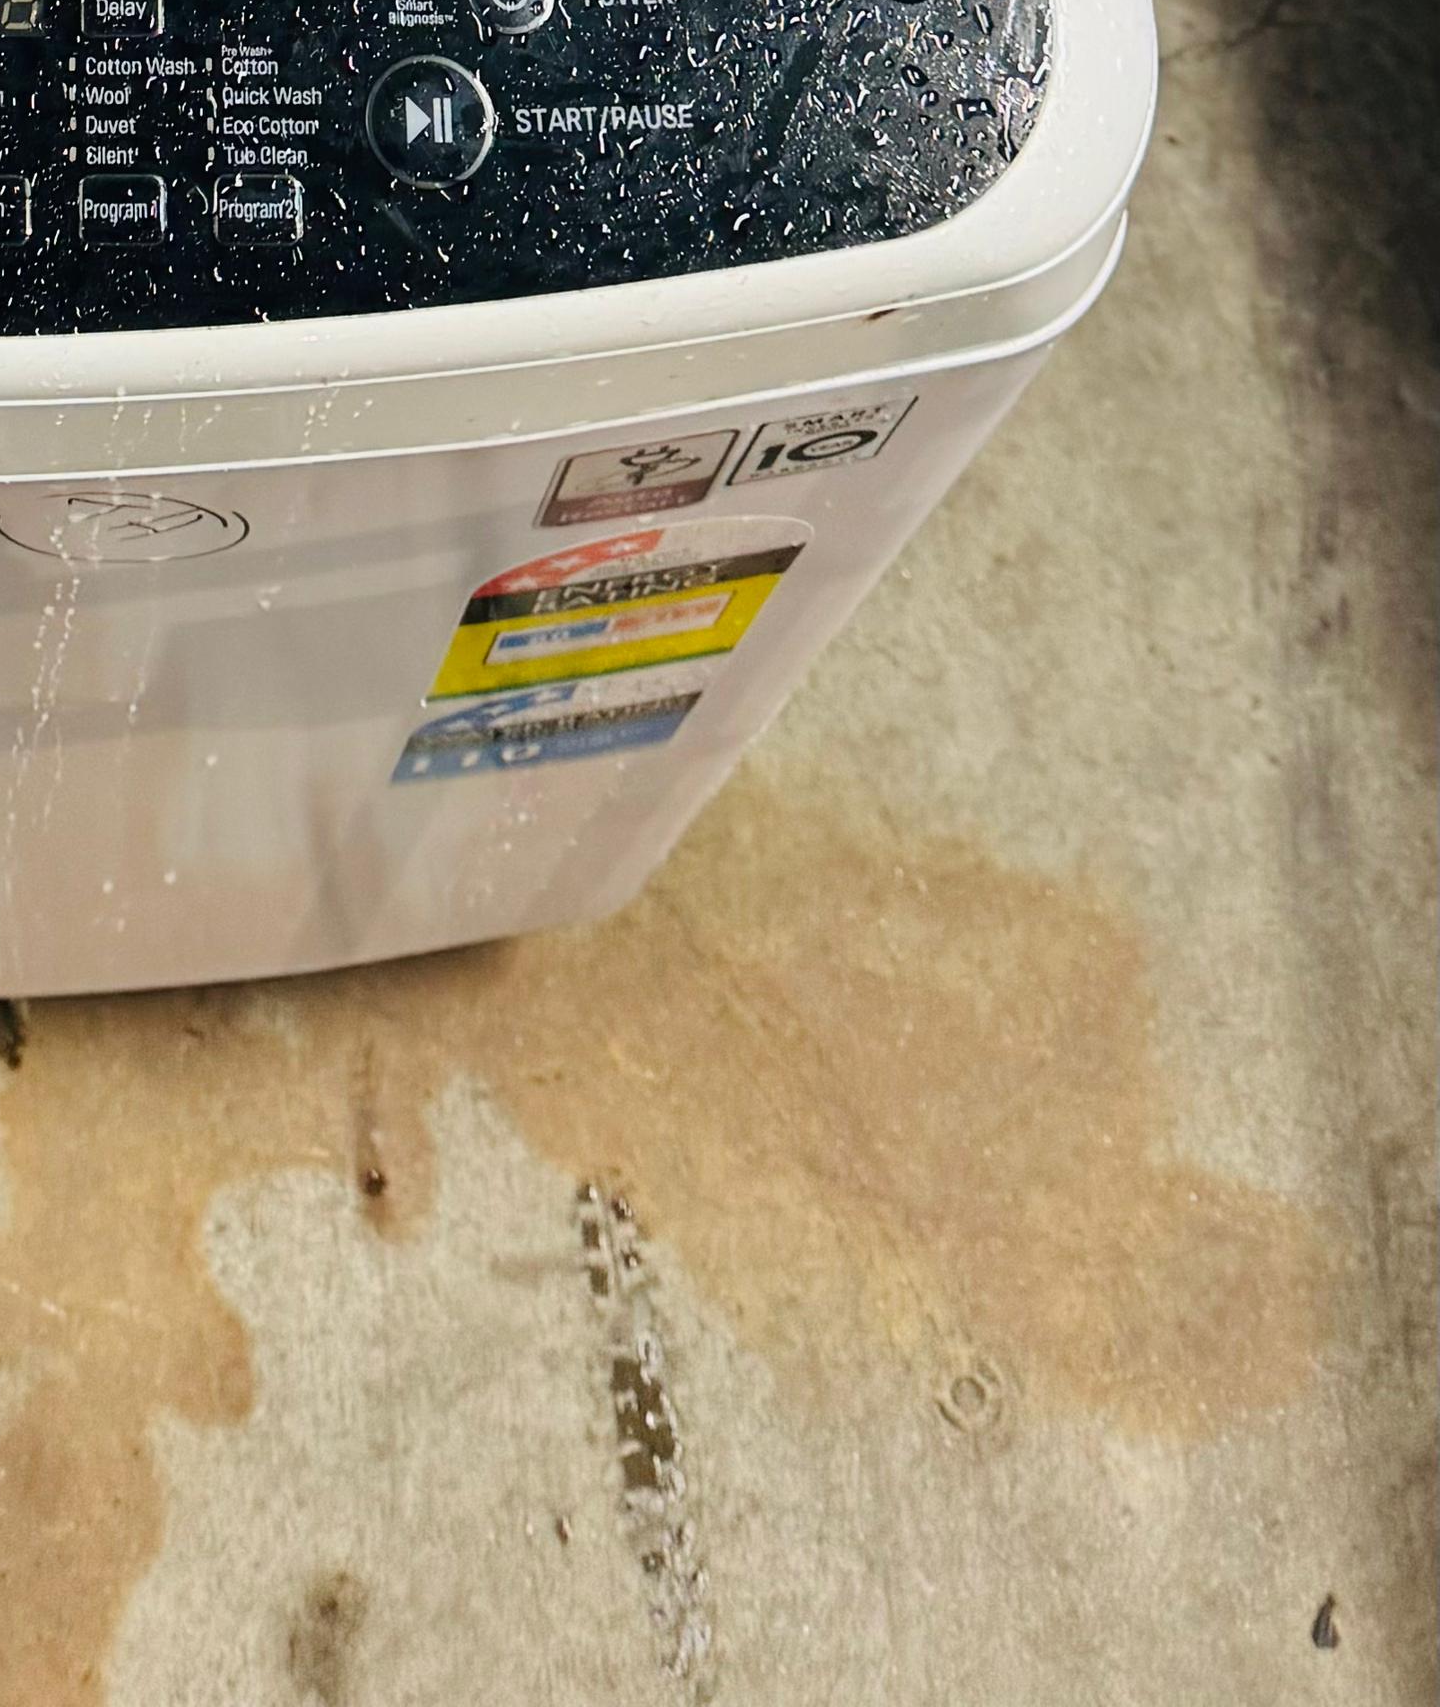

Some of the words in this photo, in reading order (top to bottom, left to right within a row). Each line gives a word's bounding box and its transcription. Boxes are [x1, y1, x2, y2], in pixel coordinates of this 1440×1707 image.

[86, 57, 142, 75] Cotton
[146, 57, 195, 75] Wash
[222, 57, 278, 75] Cotton
[86, 86, 129, 105] Wool
[222, 87, 270, 106] Quick
[273, 87, 322, 105] Wash
[86, 116, 136, 134] Duvet
[223, 116, 254, 135] Eco
[259, 116, 316, 135] Cotton
[516, 104, 695, 134] START/PAUSE
[86, 146, 135, 165] Silent
[224, 146, 255, 164] Tub
[260, 146, 308, 165] Clean
[84, 199, 148, 225] Program
[220, 199, 280, 223] Program
[284, 199, 294, 219] 2
[756, 430, 878, 471] 10
